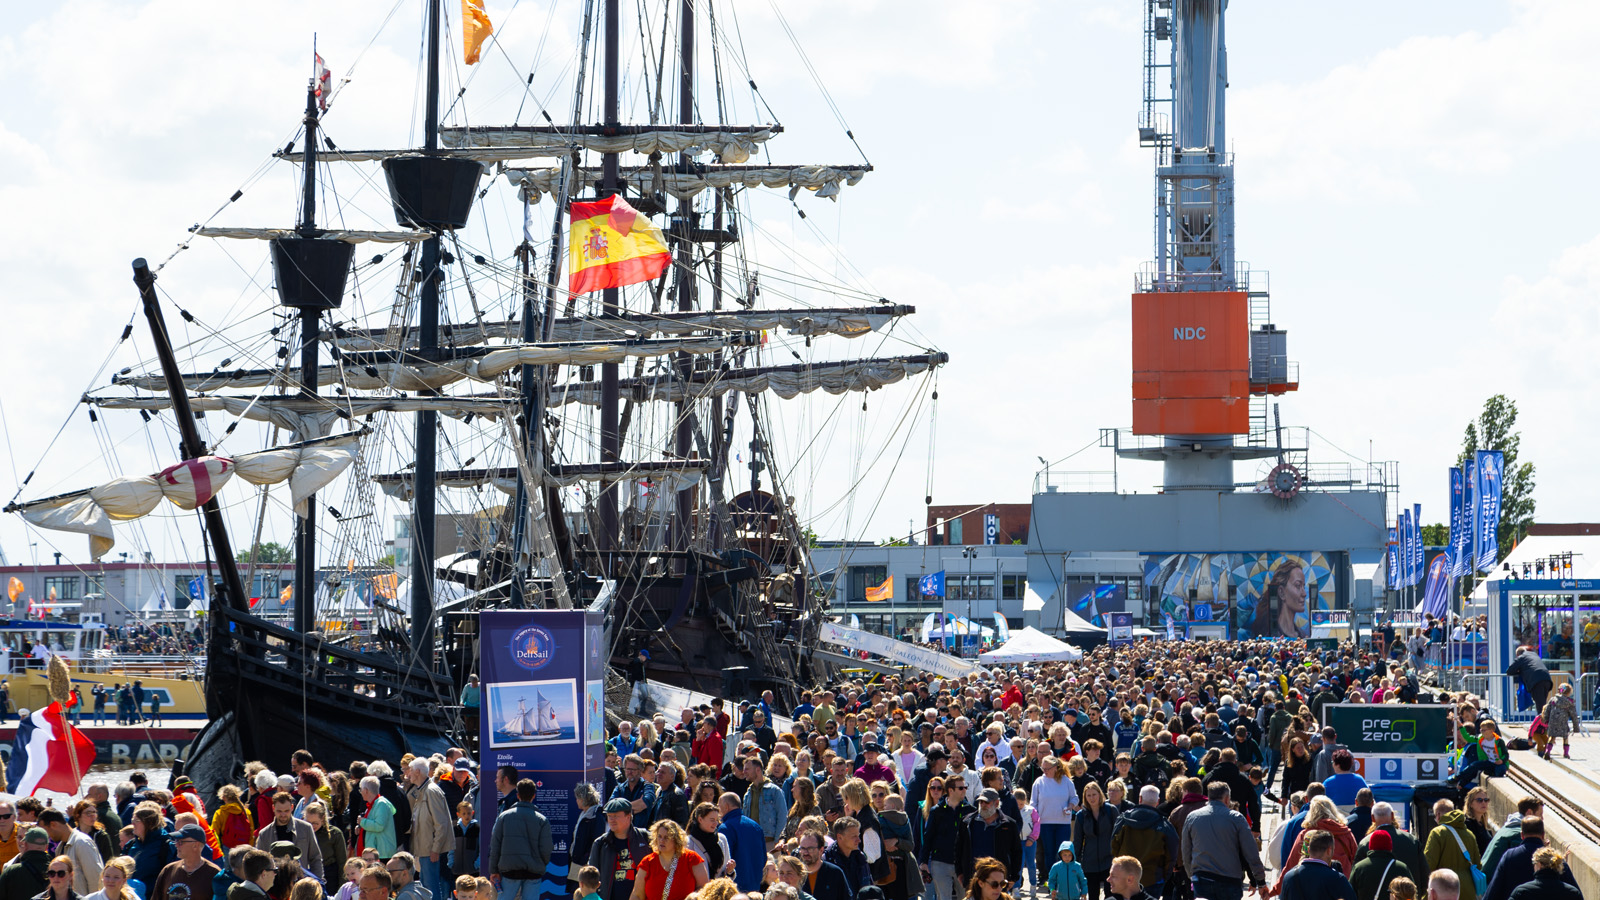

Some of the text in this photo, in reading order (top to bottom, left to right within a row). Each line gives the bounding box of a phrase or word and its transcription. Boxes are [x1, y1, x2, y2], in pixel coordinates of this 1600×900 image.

[1173, 326, 1206, 340] NDC
[516, 650, 548, 659] DelfSail
[1362, 719, 1391, 731] pre
[1362, 732, 1401, 741] zero
